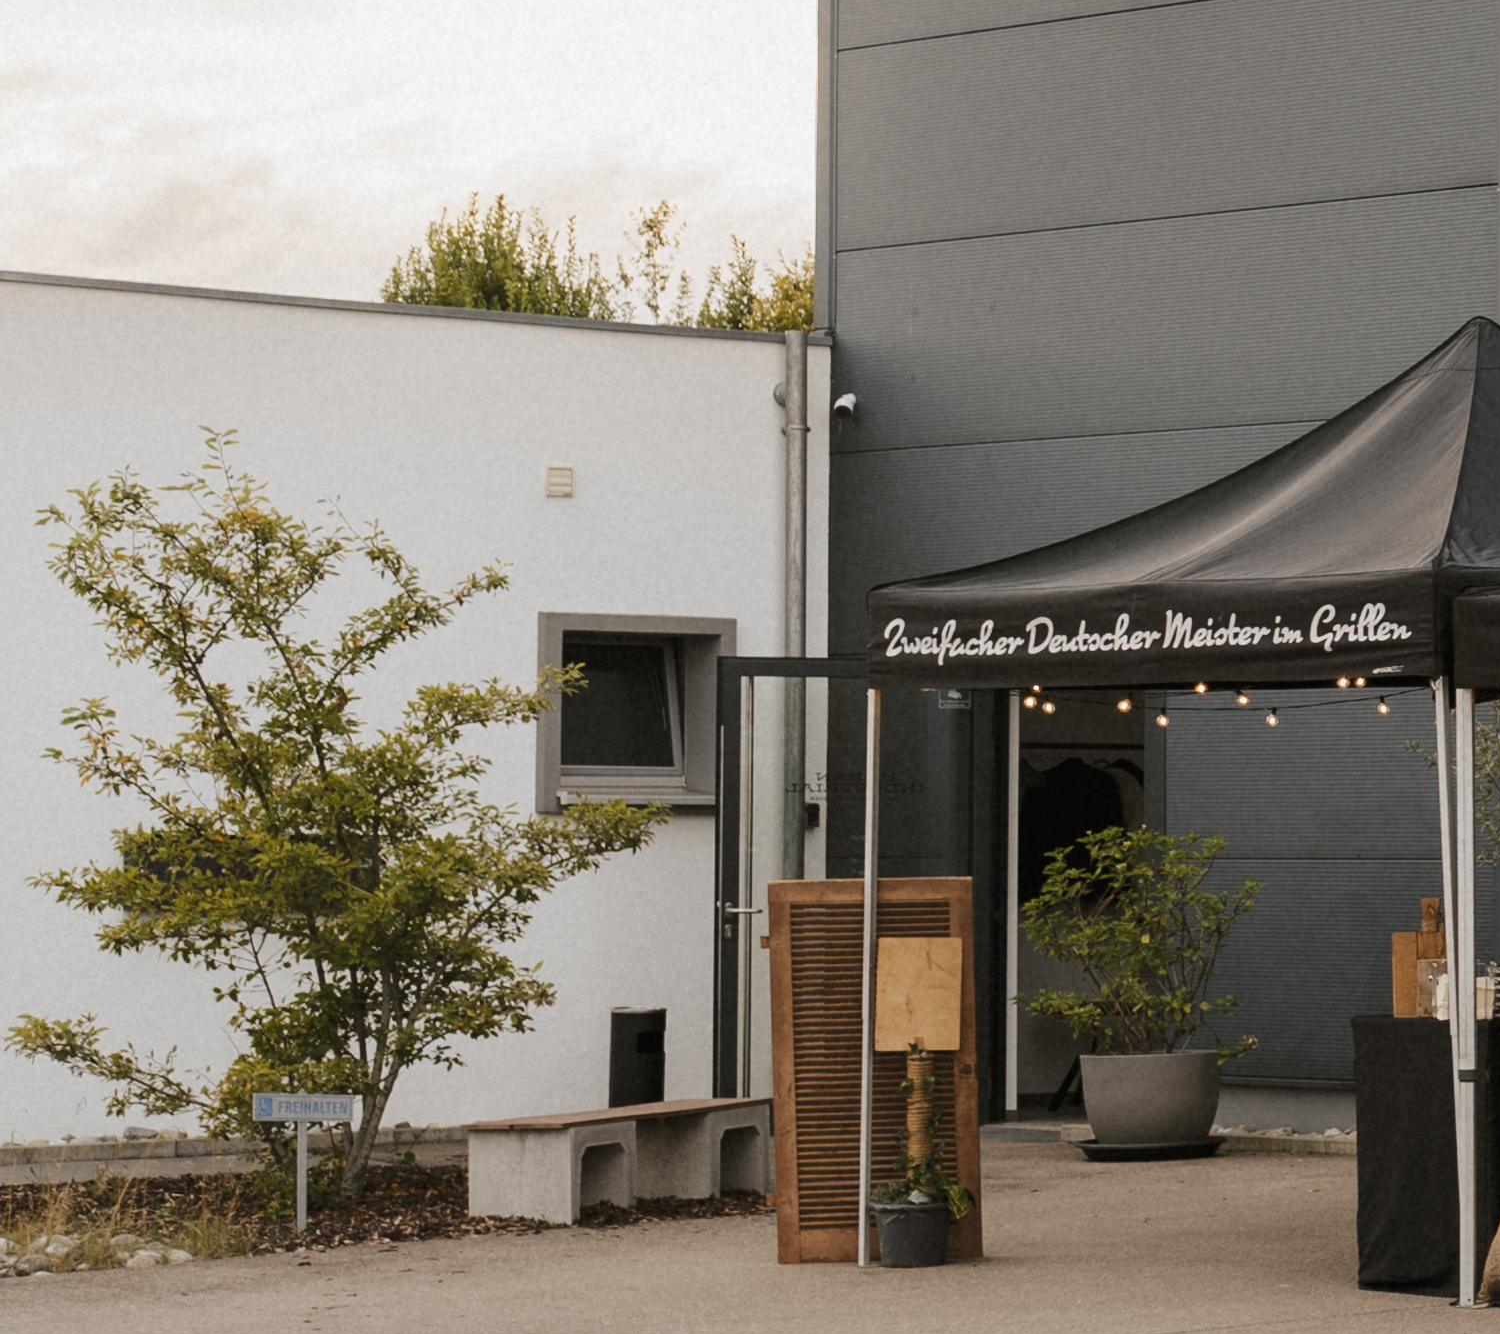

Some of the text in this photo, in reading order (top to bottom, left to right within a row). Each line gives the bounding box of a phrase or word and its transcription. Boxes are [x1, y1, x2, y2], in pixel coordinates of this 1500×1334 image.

[884, 603, 1412, 666] Zweifacher Deutscher Meister im Grillen
[278, 1101, 348, 1114] FREIHALTEN
